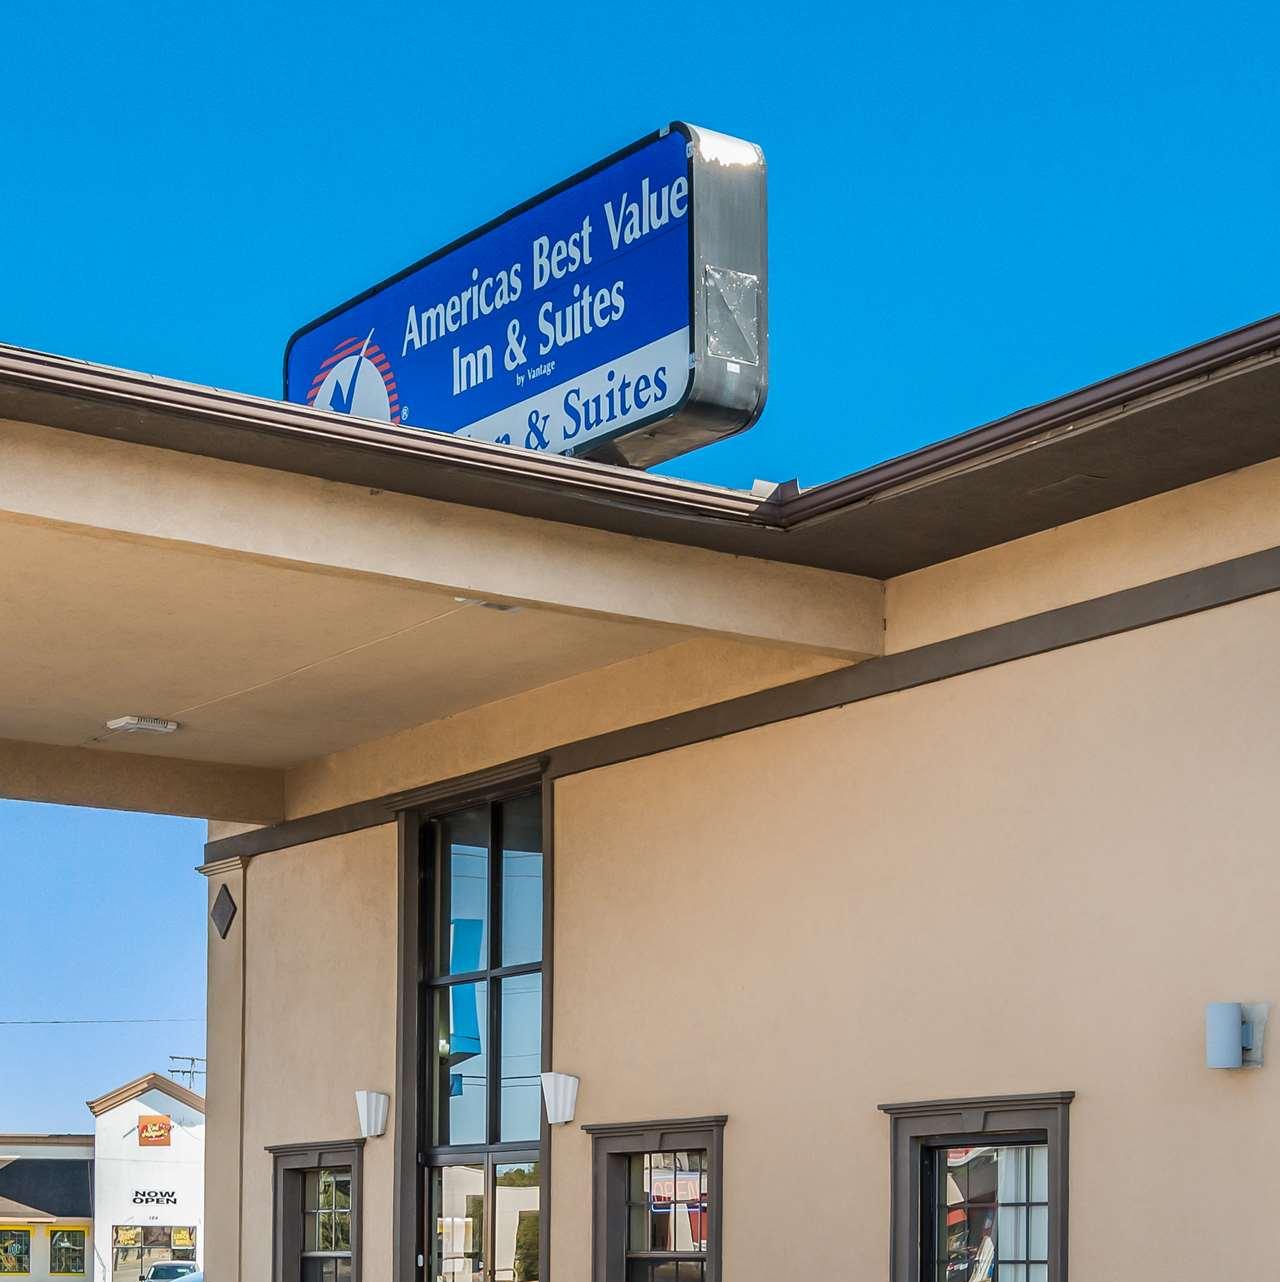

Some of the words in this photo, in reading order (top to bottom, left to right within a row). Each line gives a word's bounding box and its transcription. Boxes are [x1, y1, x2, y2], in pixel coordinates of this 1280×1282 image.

[402, 263, 522, 357] Americas
[533, 215, 592, 291] Best
[604, 175, 688, 250] Value
[453, 344, 493, 396] Inn
[504, 318, 527, 371] &
[538, 281, 624, 356] Suites
[516, 374, 525, 388] by
[527, 360, 555, 382] Vantage
[525, 409, 550, 450] &
[563, 366, 667, 440] Suites
[654, 1181, 699, 1202] OPEN
